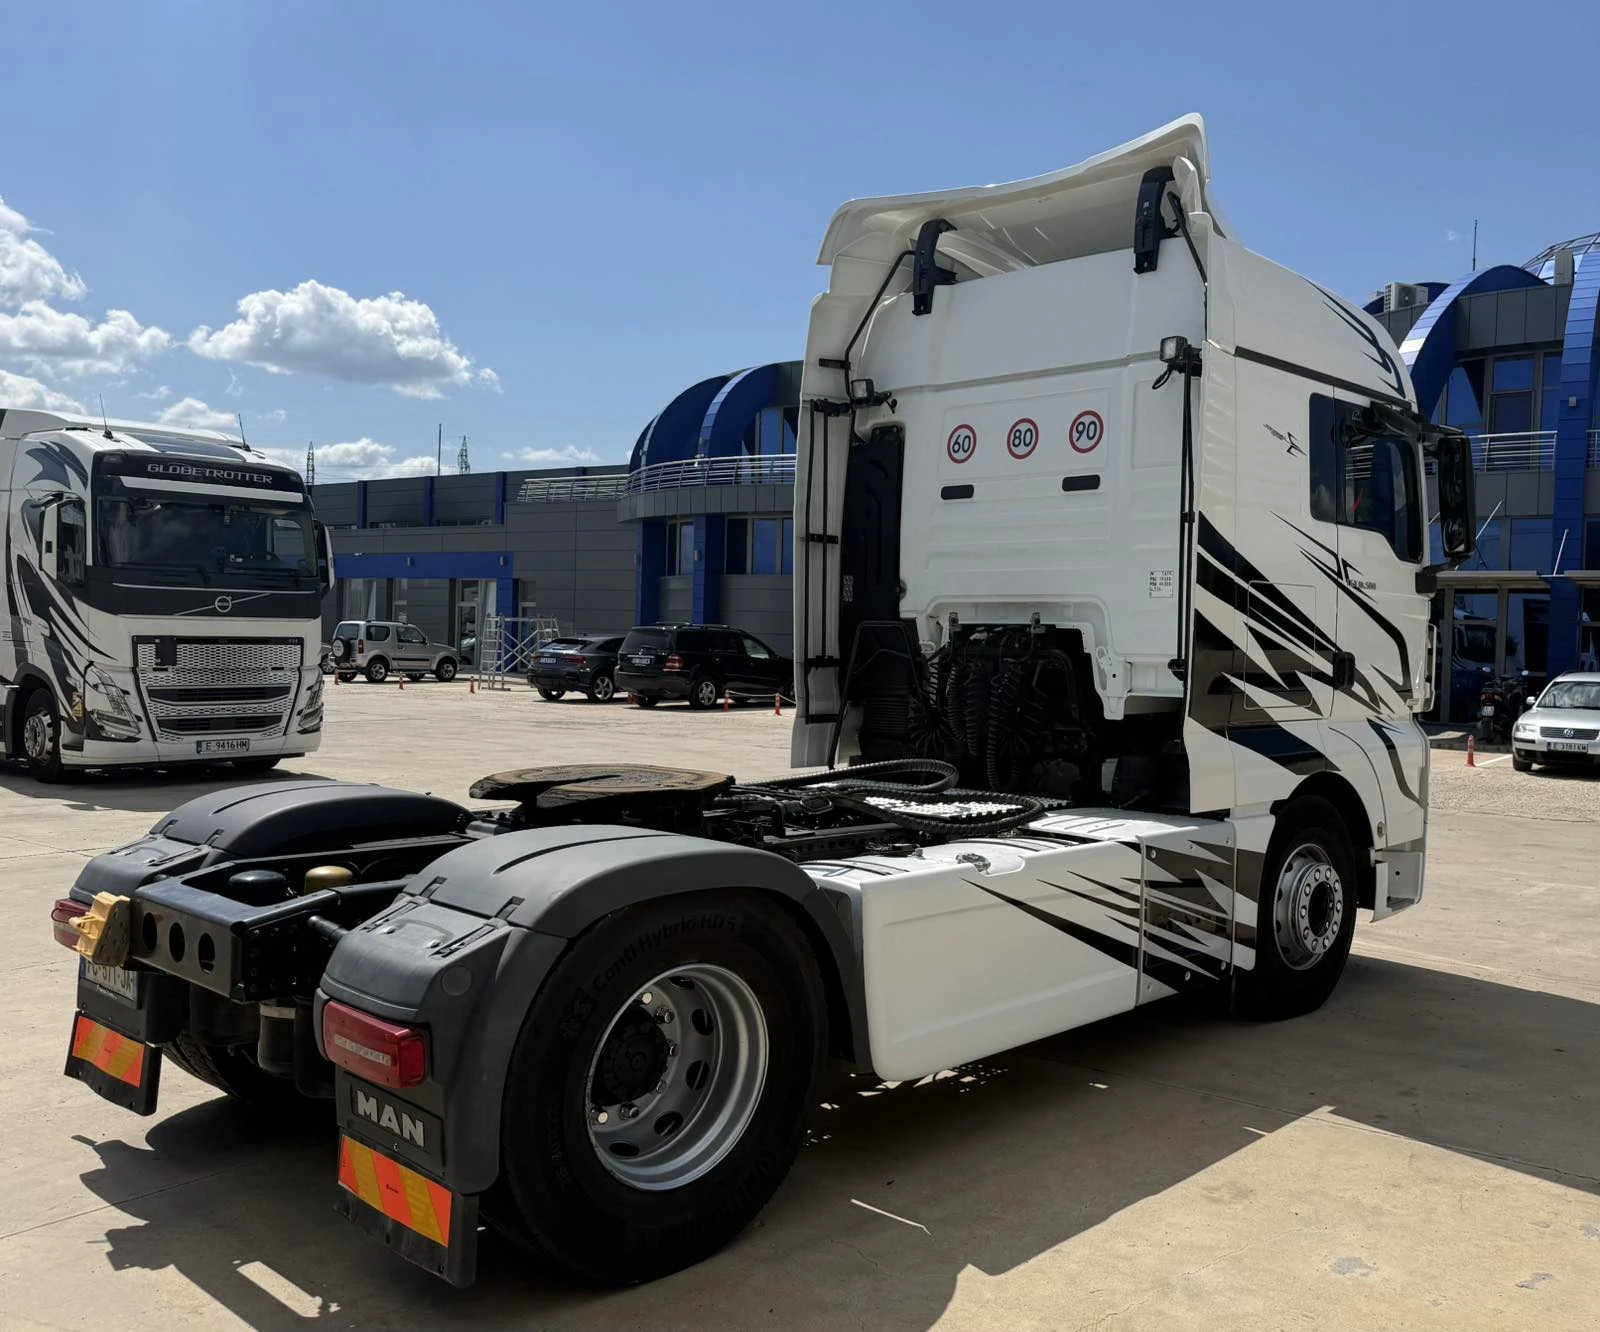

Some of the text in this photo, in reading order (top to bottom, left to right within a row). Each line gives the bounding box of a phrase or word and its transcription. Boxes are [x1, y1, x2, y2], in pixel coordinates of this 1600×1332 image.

[1012, 428, 1033, 448] 80
[1075, 420, 1098, 442] 90
[952, 434, 971, 454] 60
[147, 463, 273, 484] GLOBETROTTER
[638, 915, 697, 952] Hybrid
[357, 1089, 425, 1147] MAN
